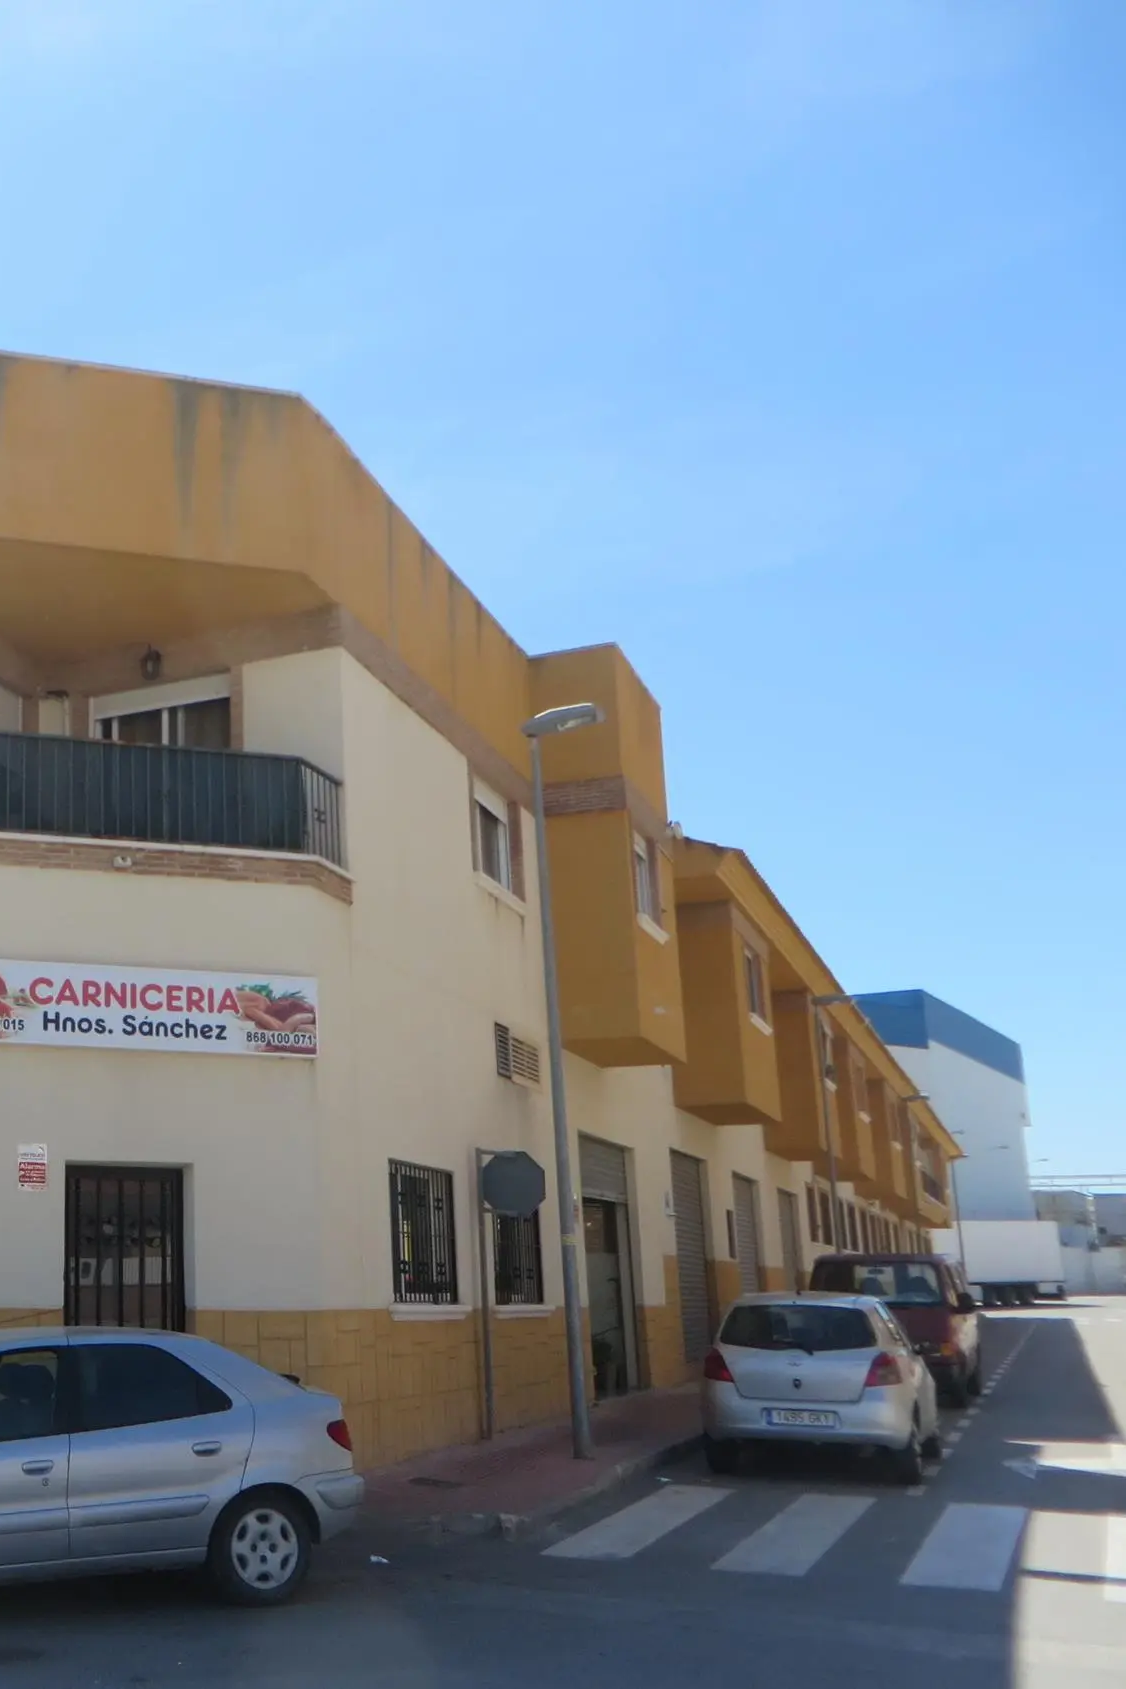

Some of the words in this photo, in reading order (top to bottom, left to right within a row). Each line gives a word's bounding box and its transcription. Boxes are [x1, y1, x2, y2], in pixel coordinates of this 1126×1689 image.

[29, 977, 240, 1015] CARNICERIA
[3, 1018, 24, 1031] 015
[42, 1010, 114, 1034] Hnos.
[122, 1014, 228, 1041] Sánchez
[246, 1031, 267, 1043] 868
[271, 1032, 290, 1044] 100
[294, 1034, 313, 1045] 071
